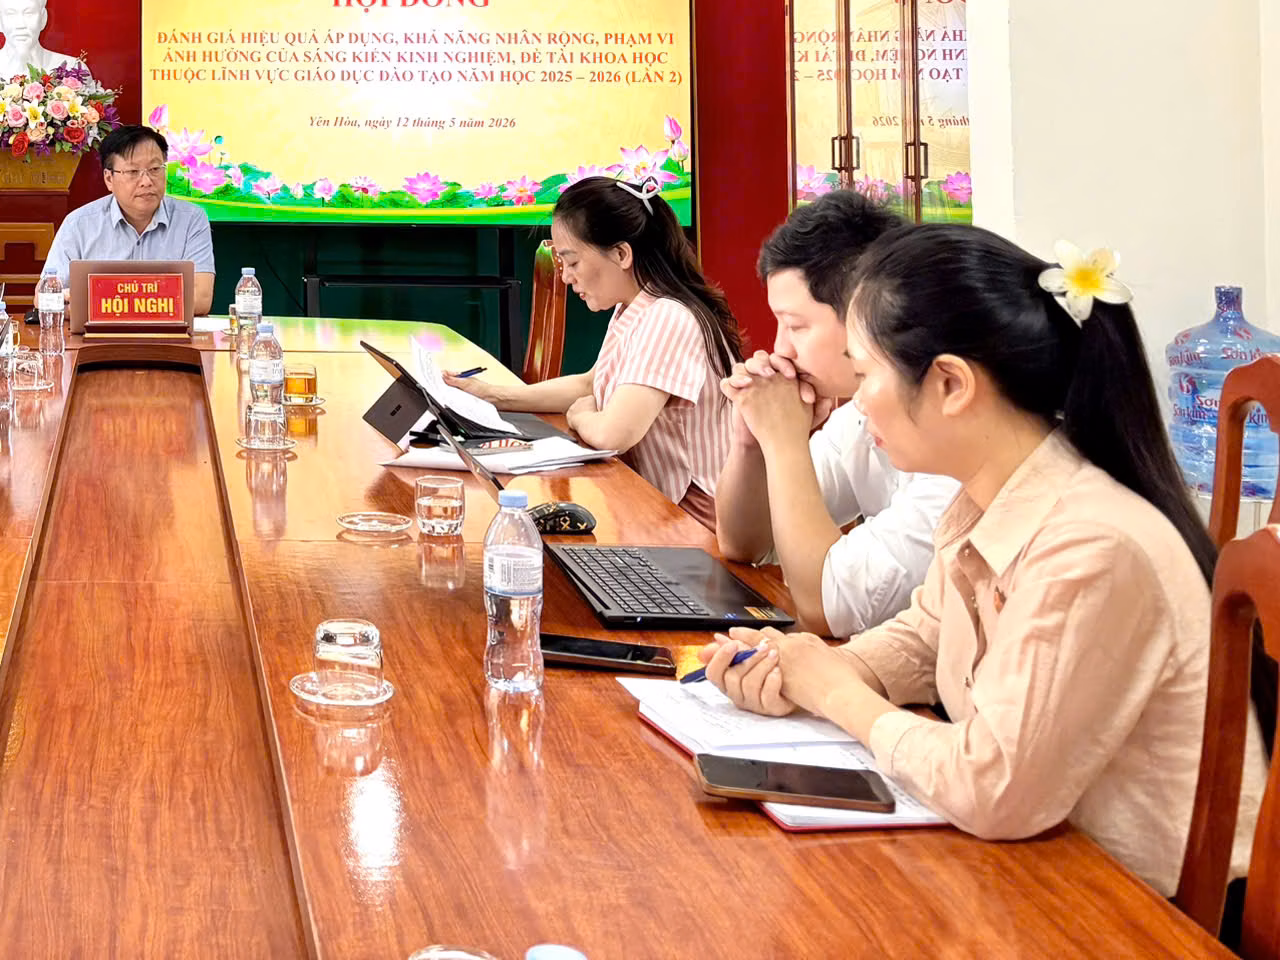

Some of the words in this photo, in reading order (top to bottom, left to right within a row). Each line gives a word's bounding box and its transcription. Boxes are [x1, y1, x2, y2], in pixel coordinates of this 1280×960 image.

[157, 28, 202, 44] ĐÁNH
[207, 28, 236, 44] GIÁ
[241, 30, 280, 47] HIỆU
[284, 28, 319, 46] QUẢ
[323, 28, 345, 44] ÁP
[348, 32, 399, 47] DỤNG,
[404, 29, 439, 44] KHẢ
[444, 29, 491, 44] NĂNG
[495, 29, 542, 45] NHÂN
[547, 30, 600, 47] RỘNG,
[604, 32, 652, 48] PHẠM
[657, 32, 674, 45] VI
[163, 47, 197, 62] ẢNH
[202, 47, 261, 62] HƯỞNG
[266, 47, 299, 63] CỦA
[303, 47, 347, 63] SÁNG
[397, 51, 438, 63] KINH
[443, 49, 516, 66] NGHIỆM,
[546, 47, 574, 64] TÀI
[580, 51, 628, 64] KHOA
[632, 51, 669, 67] HỌC
[149, 67, 206, 84] THUỘC
[211, 66, 250, 81] LĨNH
[255, 67, 289, 84] VỰC
[294, 66, 336, 82] GIÁO
[340, 69, 374, 84] DỤC
[418, 70, 452, 85] TẠO
[457, 67, 495, 82] NĂM
[500, 70, 536, 85] HỌC
[540, 70, 573, 83] 2025
[589, 71, 621, 83] 2026
[669, 71, 683, 86] 2)
[309, 116, 330, 127] Yên
[333, 116, 361, 128] Hòa,
[364, 116, 393, 130] ngày
[396, 116, 410, 128] 12
[412, 116, 445, 130] tháng
[448, 117, 457, 128] 5
[459, 117, 485, 128] năm
[488, 117, 517, 128] 2026
[117, 280, 138, 293] CHỦ
[141, 280, 159, 293] TRÌ
[101, 295, 129, 317] HỘI
[134, 297, 174, 317] NGHỊ
